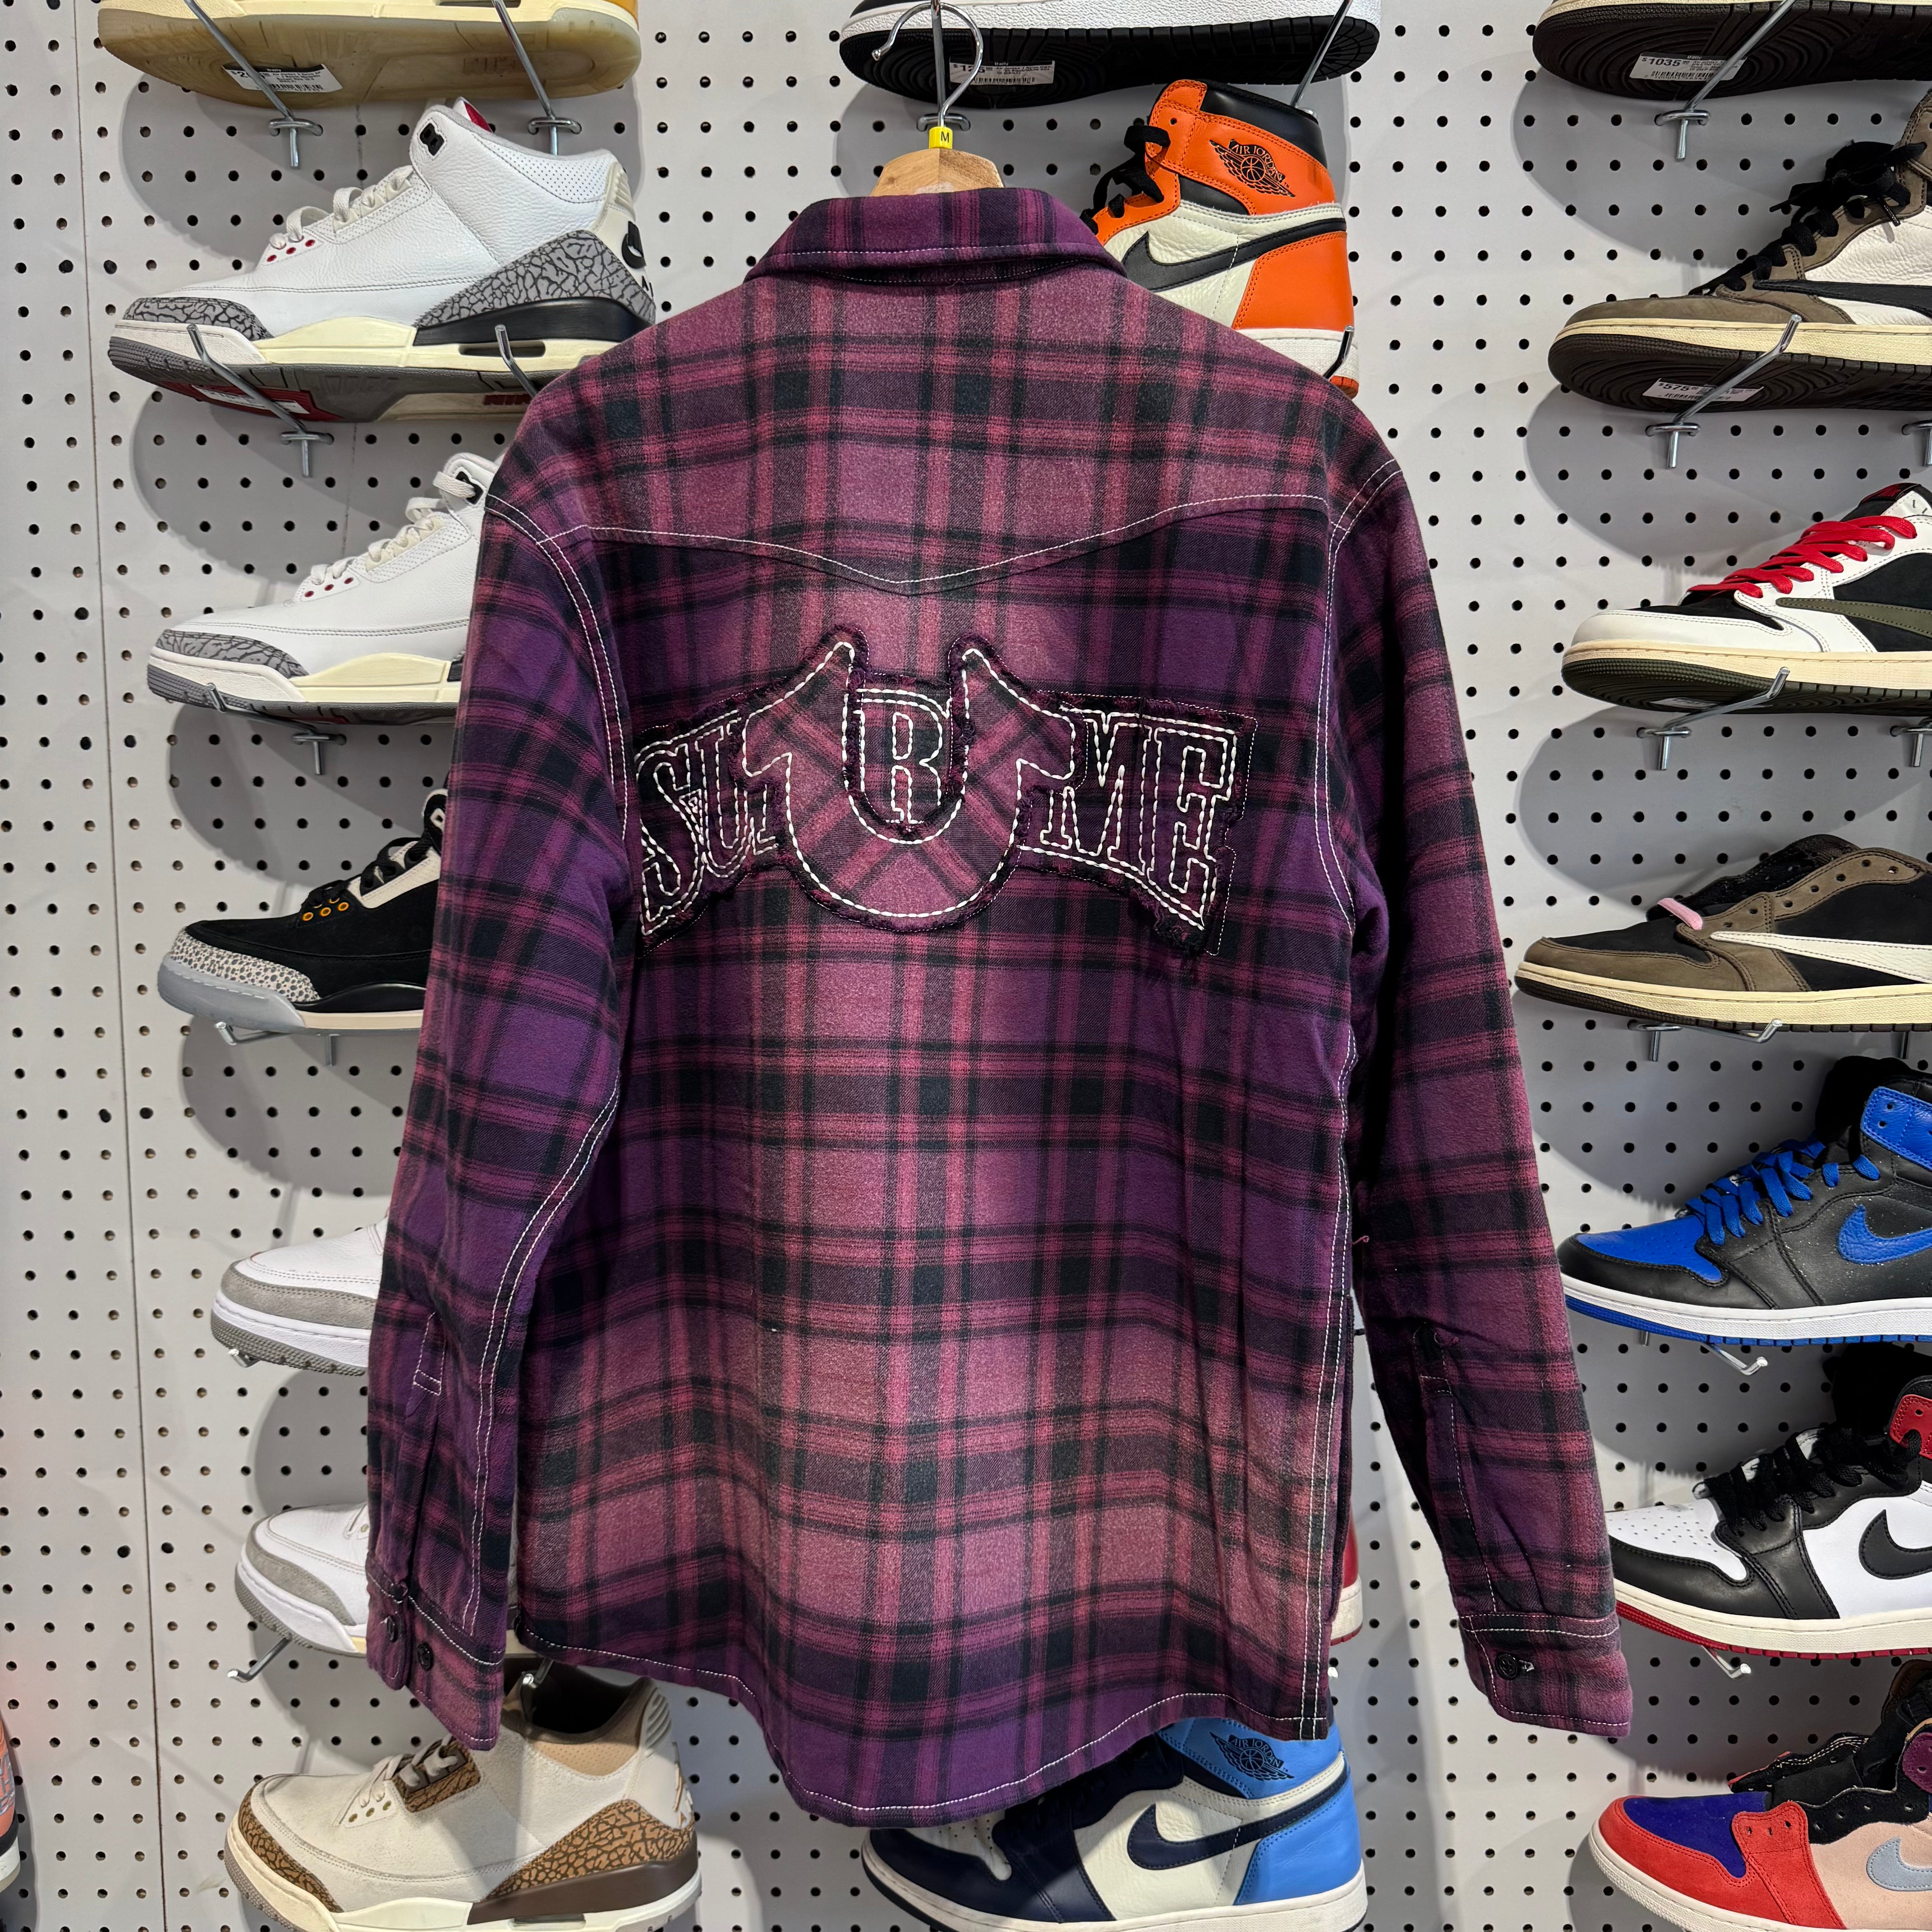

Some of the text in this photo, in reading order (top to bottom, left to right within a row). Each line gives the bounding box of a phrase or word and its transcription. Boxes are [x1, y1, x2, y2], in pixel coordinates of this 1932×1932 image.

[941, 131, 949, 143] M
[1231, 144, 1251, 155] AIR
[1253, 145, 1283, 181] JORDAN
[1231, 1737, 1249, 1748] AIR
[1252, 1738, 1282, 1767] JORDAN
